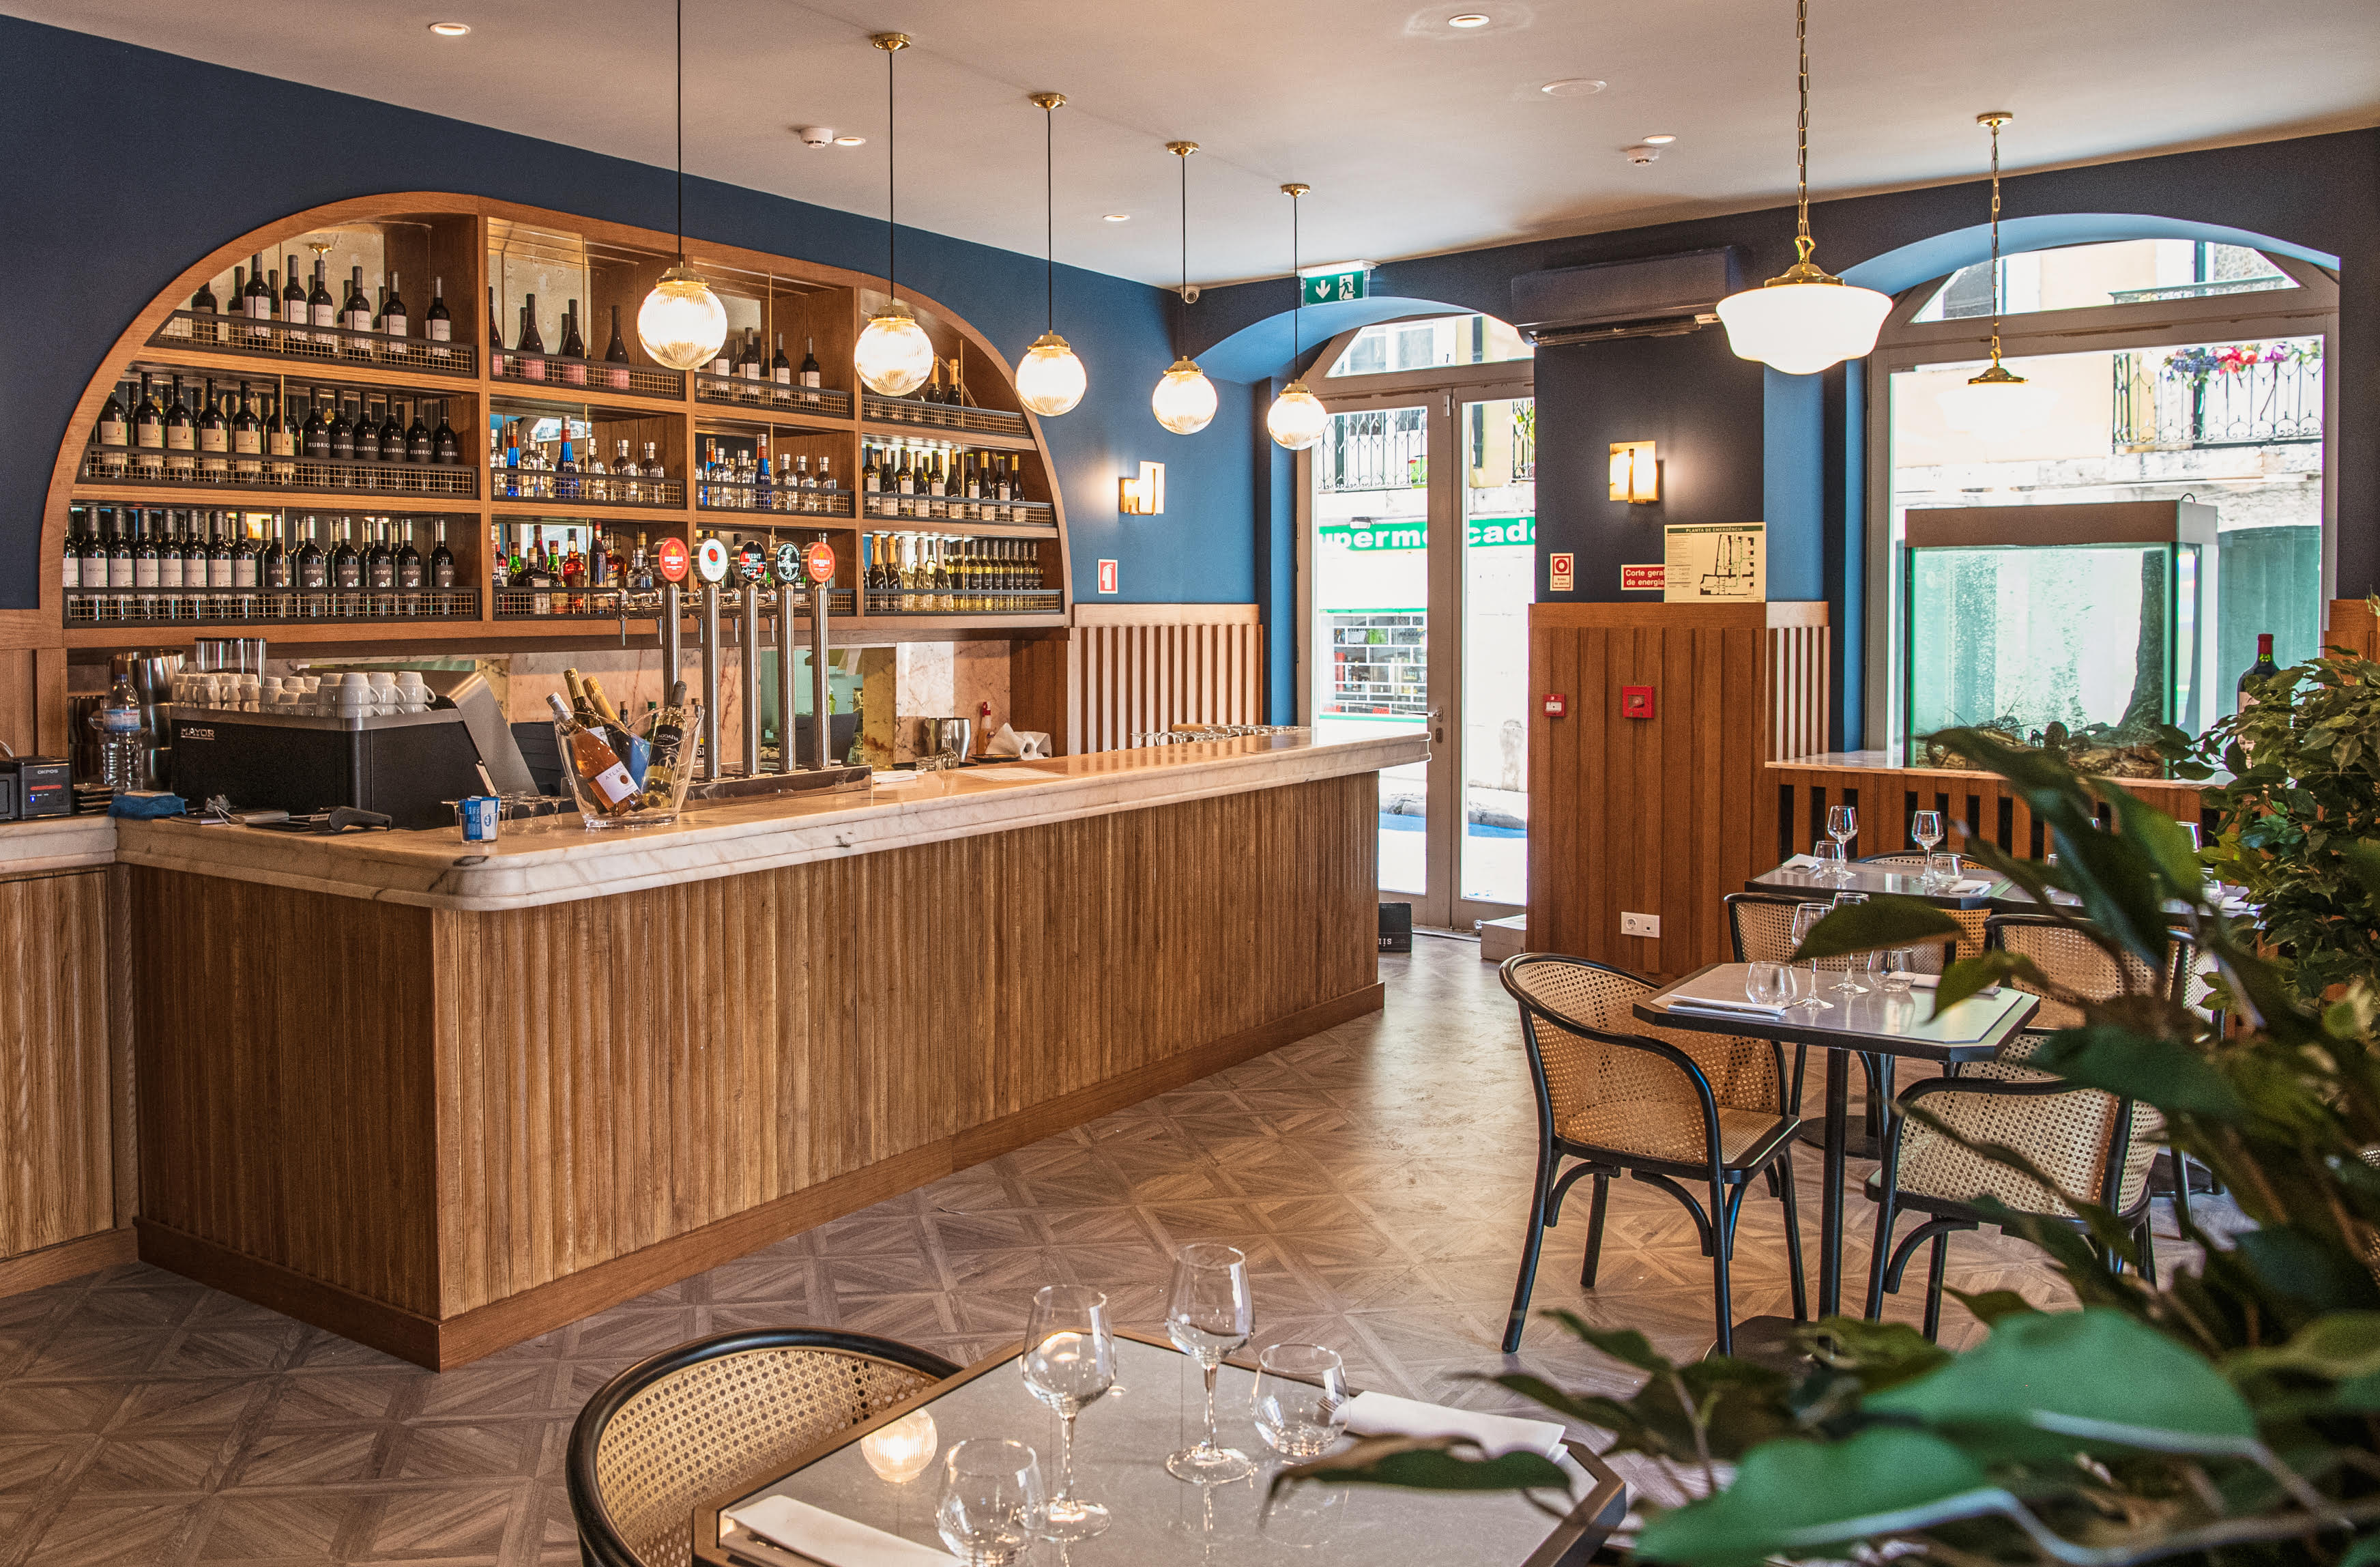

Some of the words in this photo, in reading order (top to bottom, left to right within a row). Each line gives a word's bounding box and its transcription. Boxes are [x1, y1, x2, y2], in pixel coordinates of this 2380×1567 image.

[1638, 578, 1664, 587] energia
[180, 727, 215, 738] MAYOR
[697, 747, 704, 756] 51
